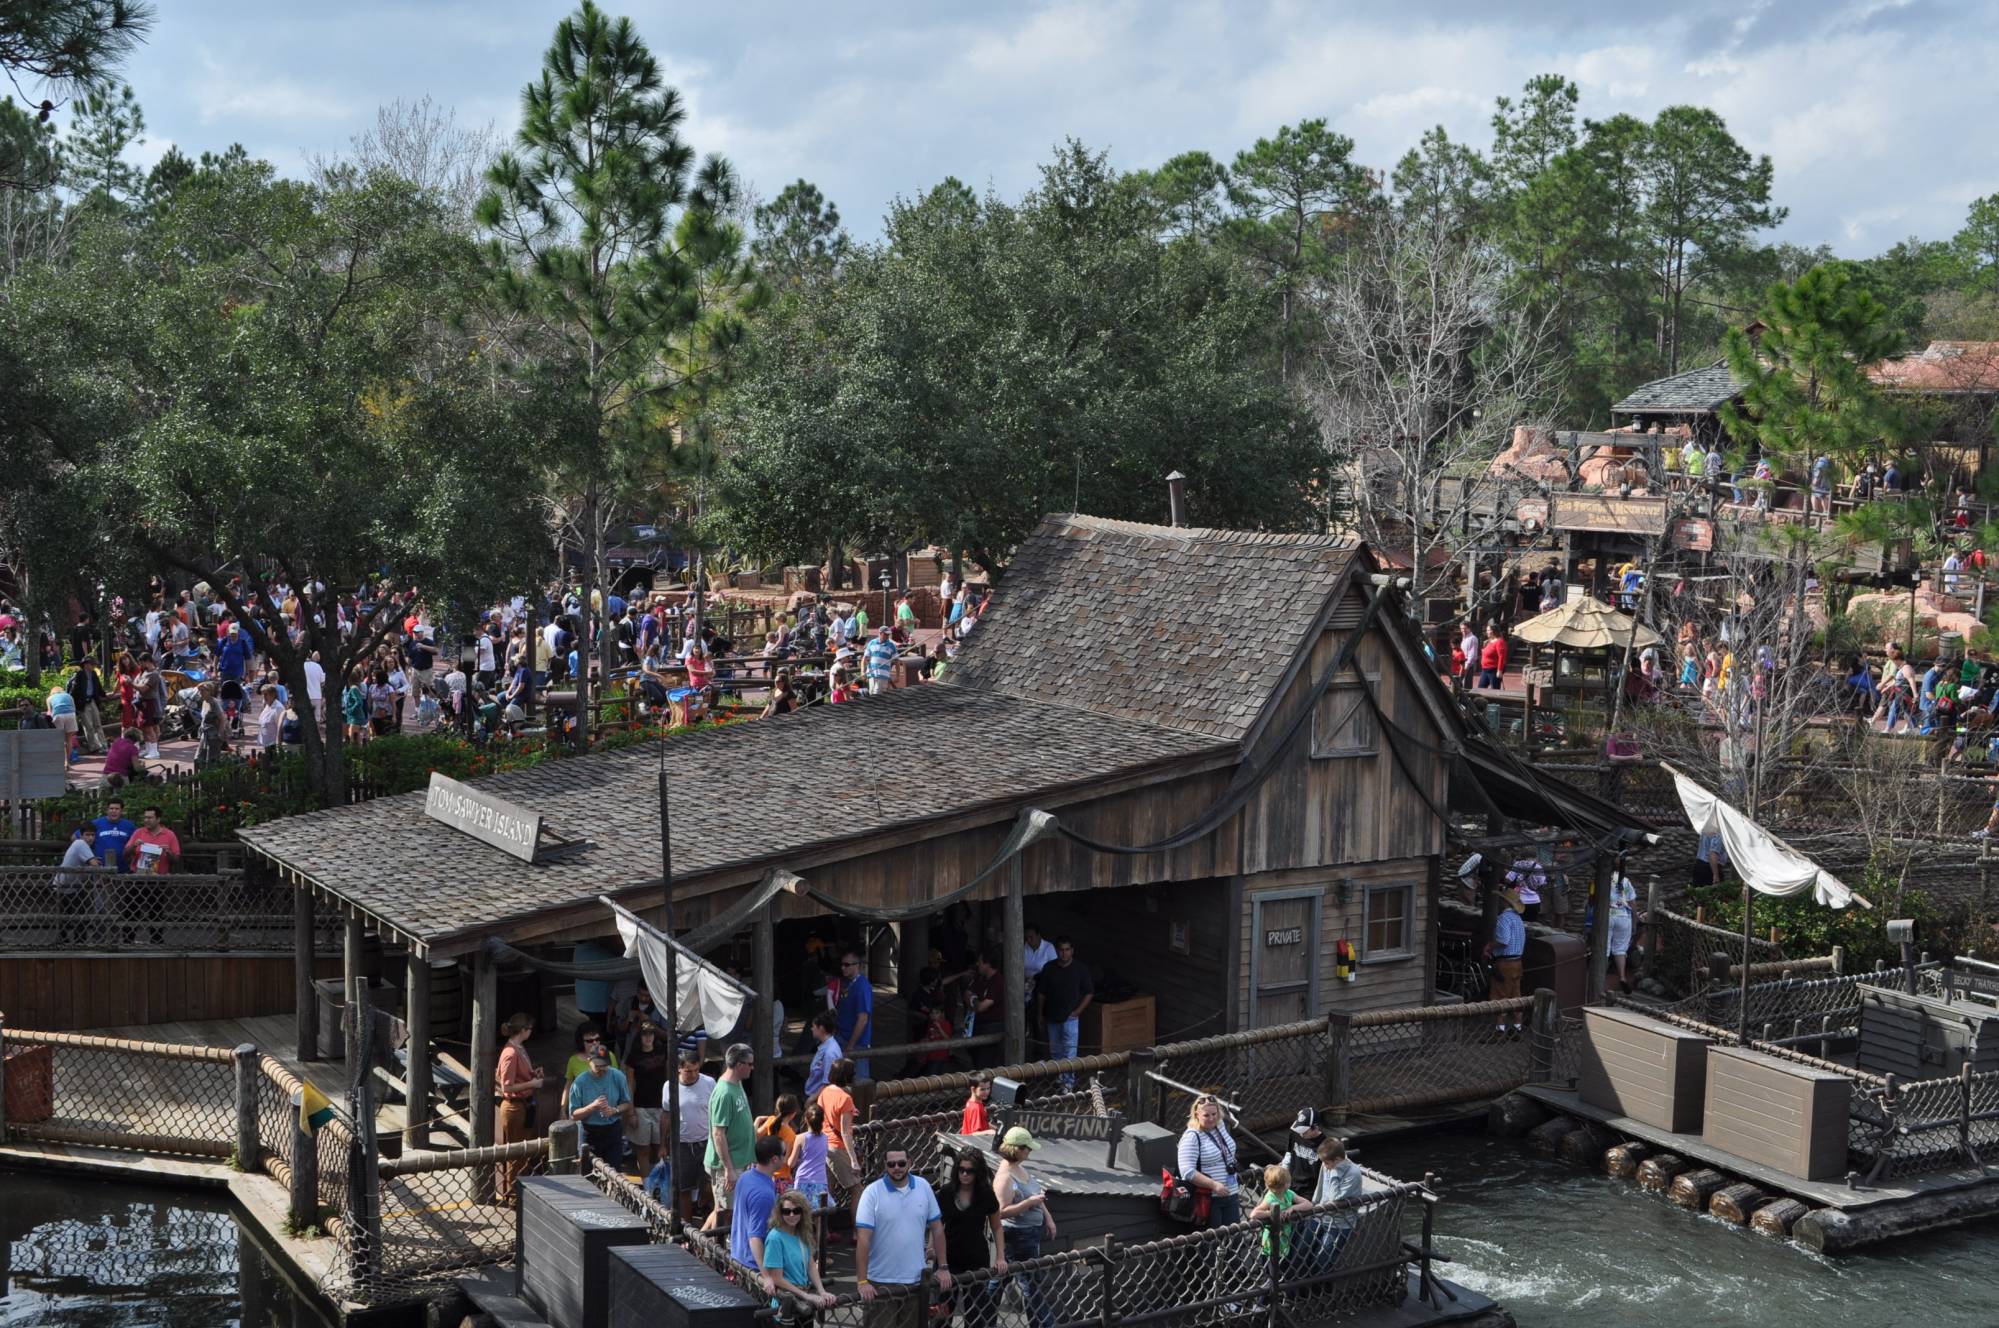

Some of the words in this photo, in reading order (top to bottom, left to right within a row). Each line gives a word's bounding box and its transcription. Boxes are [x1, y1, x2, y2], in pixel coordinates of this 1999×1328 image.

[432, 786, 453, 814] TOM
[454, 796, 493, 831] SAWYER
[493, 811, 532, 846] ISLAND
[1268, 929, 1301, 944] PRIVATE
[1018, 1114, 1059, 1134] HUCK
[1063, 1117, 1110, 1137] FINN
